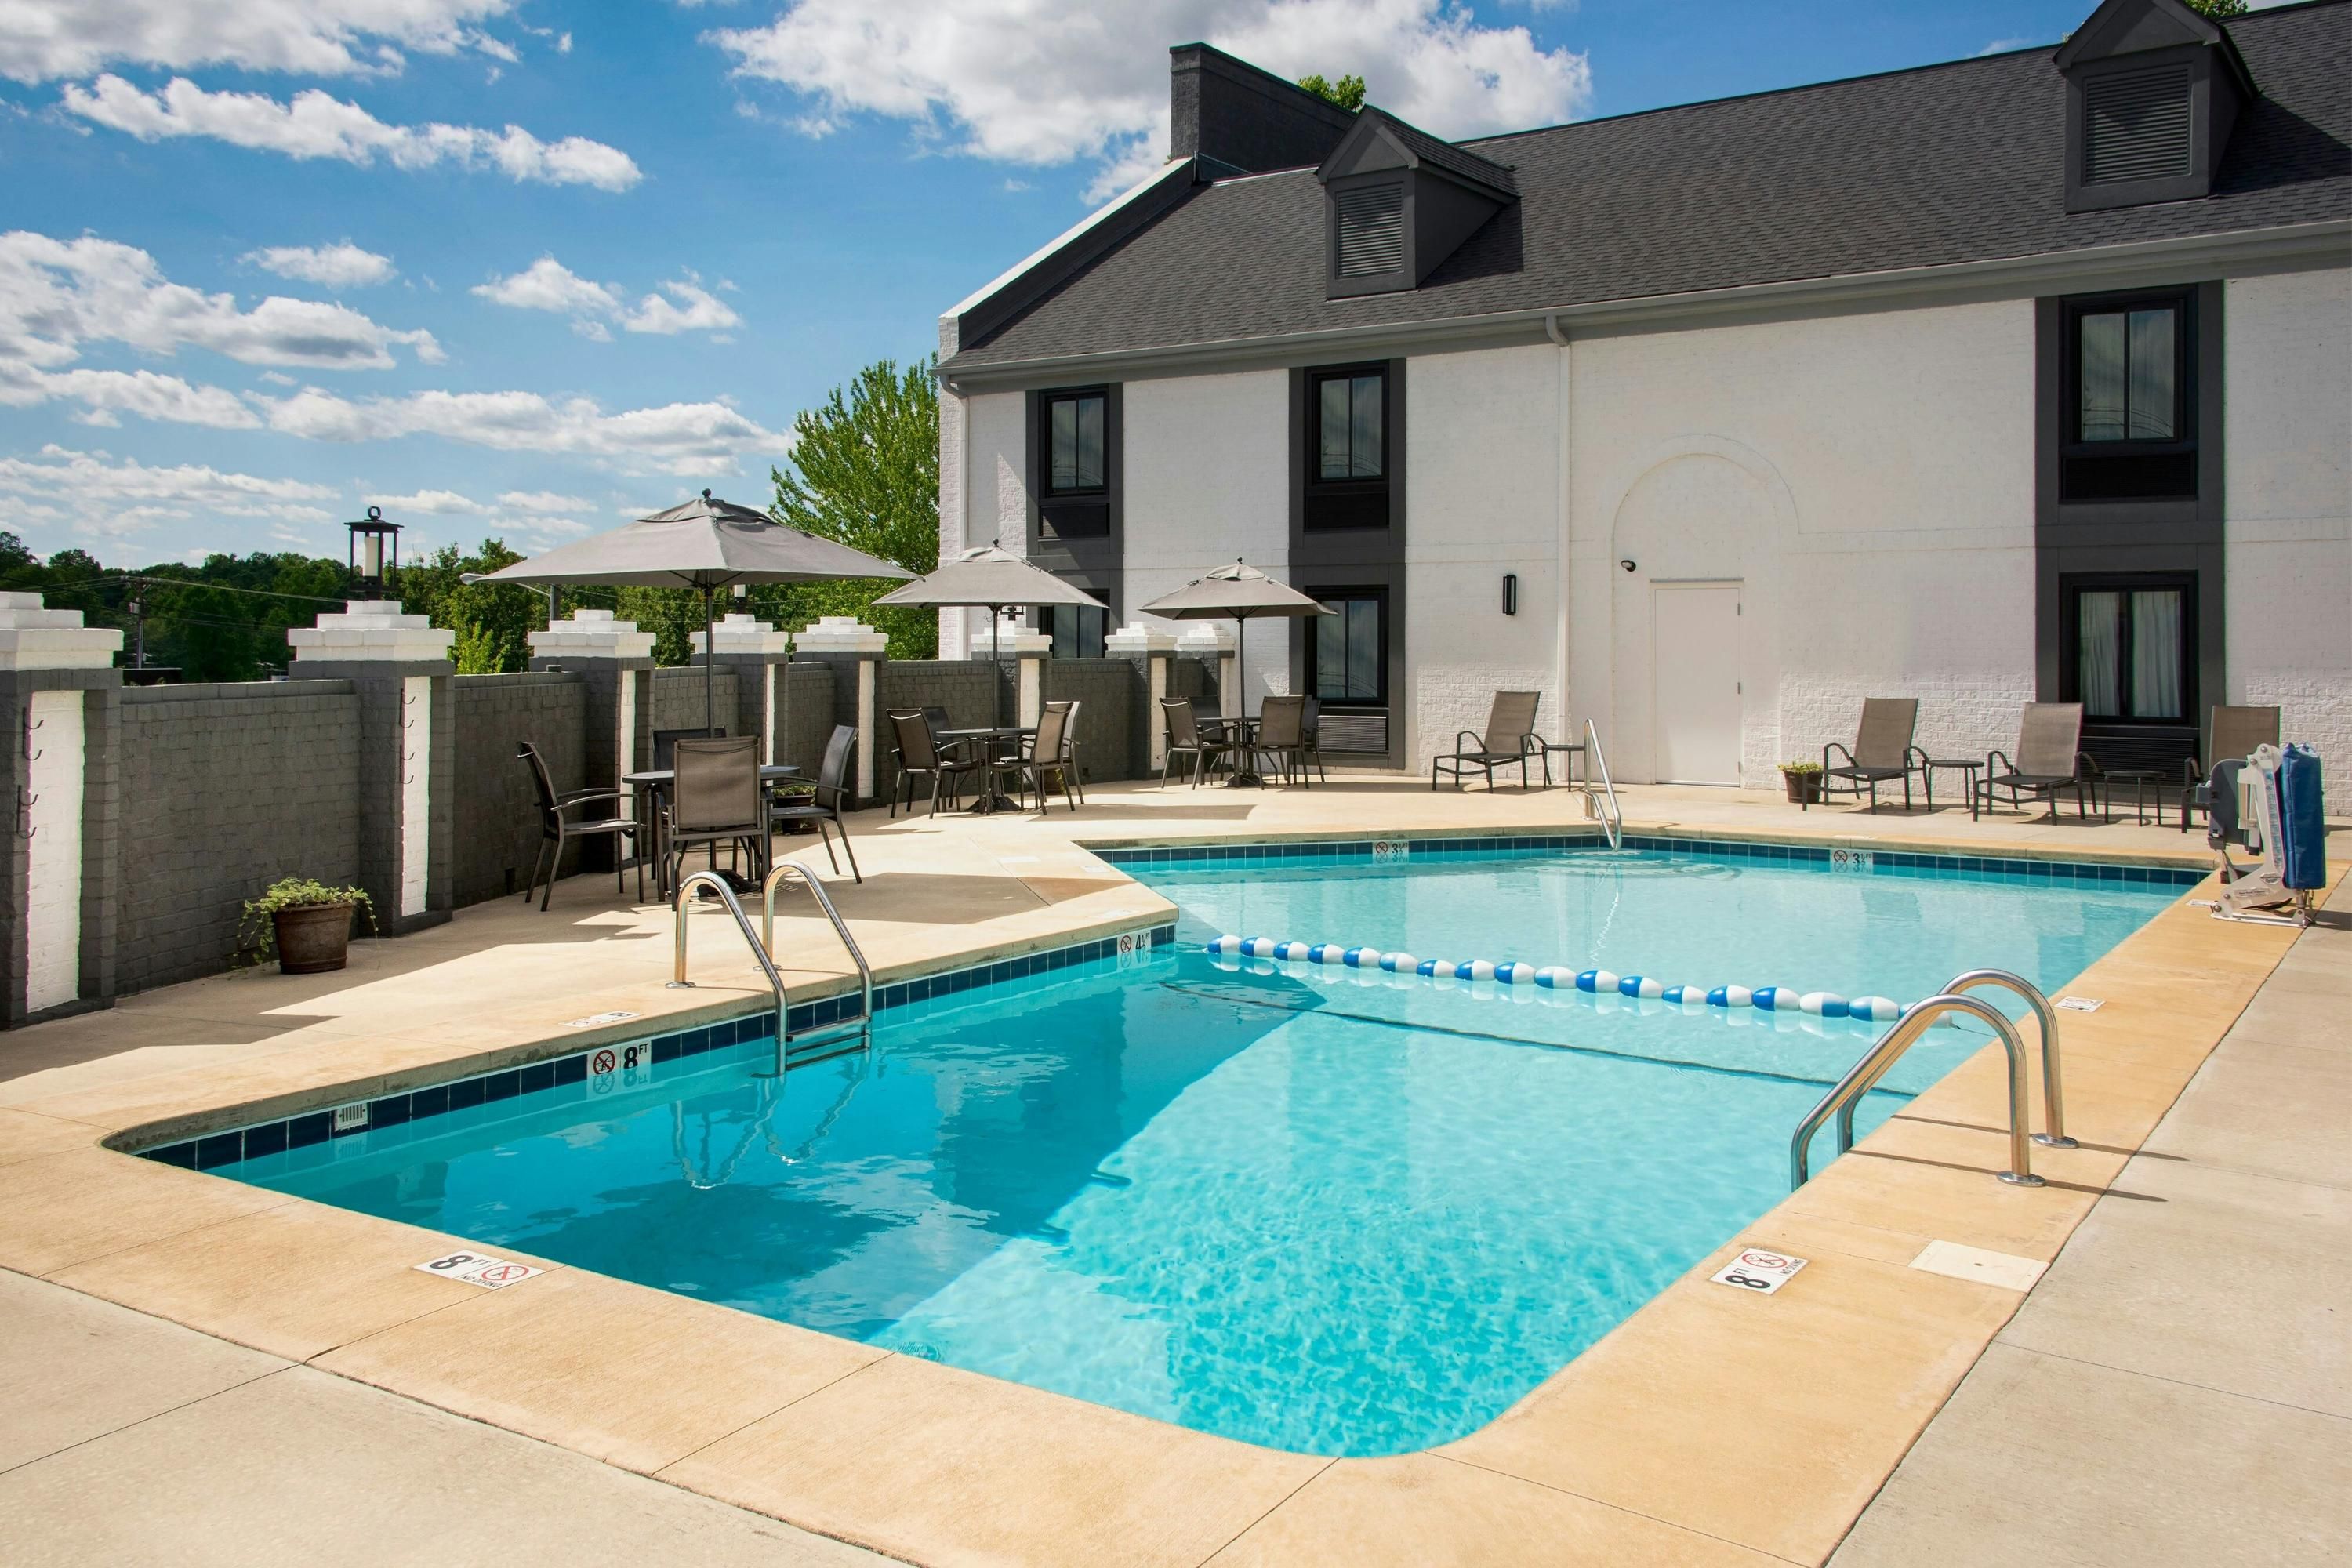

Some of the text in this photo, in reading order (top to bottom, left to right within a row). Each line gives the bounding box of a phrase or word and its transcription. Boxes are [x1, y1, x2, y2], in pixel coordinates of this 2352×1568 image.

[623, 1043, 648, 1069] 8 FT
[429, 1254, 474, 1269] 8
[472, 1278, 503, 1288] DIVING
[1725, 1275, 1771, 1288] 8
